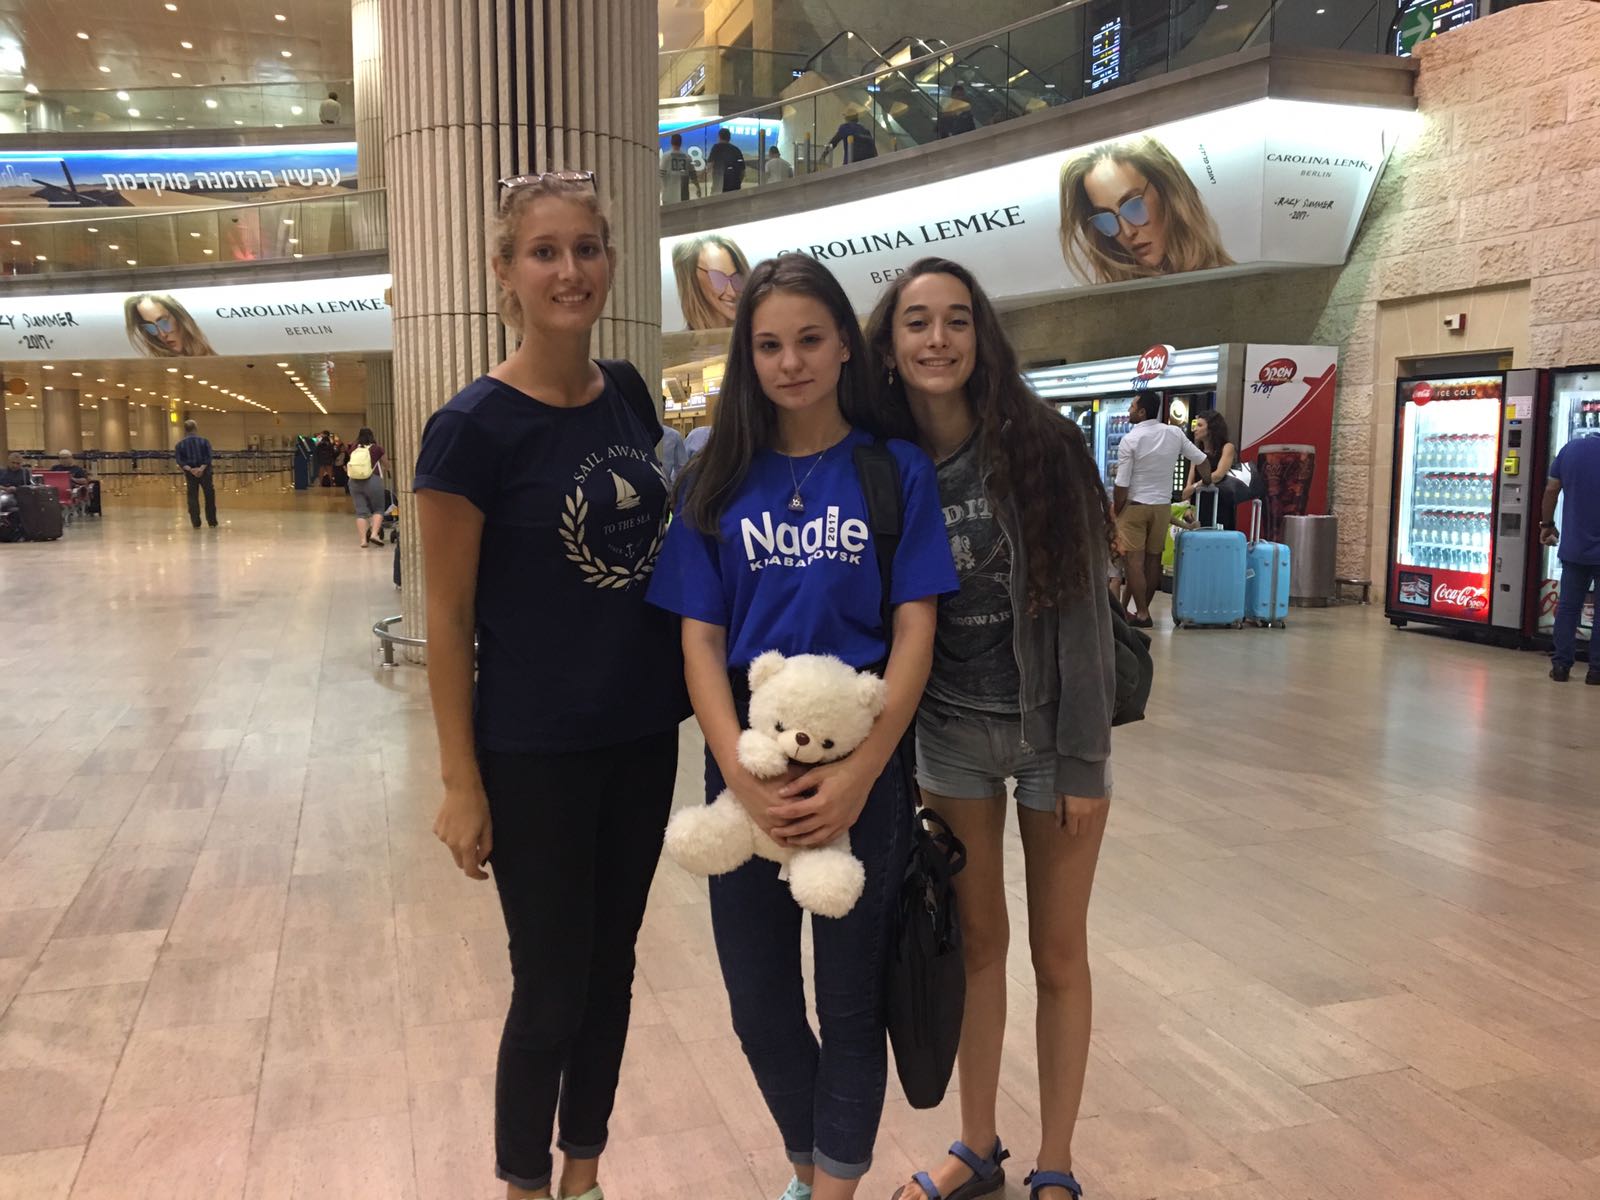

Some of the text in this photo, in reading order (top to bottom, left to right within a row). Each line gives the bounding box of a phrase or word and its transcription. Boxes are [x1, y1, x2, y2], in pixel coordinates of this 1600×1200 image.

[1267, 153, 1330, 165] CAROLINA
[102, 167, 341, 196] עכשיו בהזמנה מוקדמת
[1300, 170, 1332, 178] BERLIN
[923, 205, 1025, 243] LEMKE
[215, 298, 385, 319] CAROLINA LEMKE
[22, 311, 79, 328] SUMMER
[285, 325, 333, 336] BERLIN
[1454, 389, 1477, 397] COLD
[573, 444, 648, 484] SAIL AWAY
[603, 523, 616, 535] TO
[617, 518, 635, 531] THE
[828, 513, 836, 541] 2017
[1434, 583, 1486, 606] Coca-Co
[951, 611, 1010, 626] OGWAR
